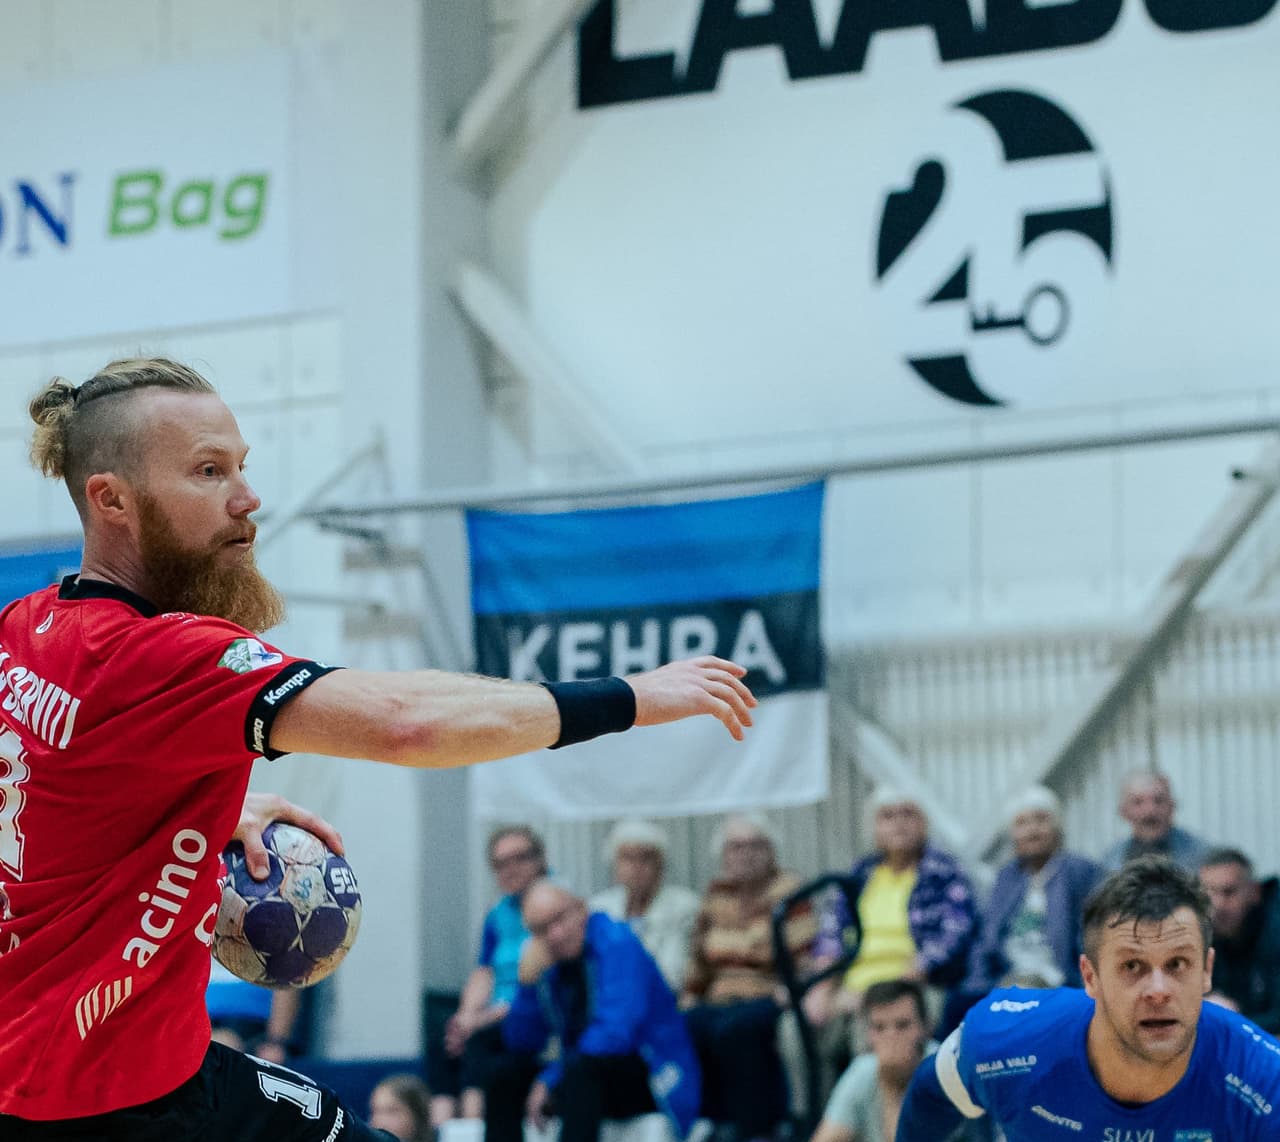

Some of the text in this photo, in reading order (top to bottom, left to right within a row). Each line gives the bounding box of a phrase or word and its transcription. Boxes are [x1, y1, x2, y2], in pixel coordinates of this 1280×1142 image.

[106, 167, 270, 241] Bag
[263, 668, 312, 706] Kempa
[121, 828, 208, 968] acino
